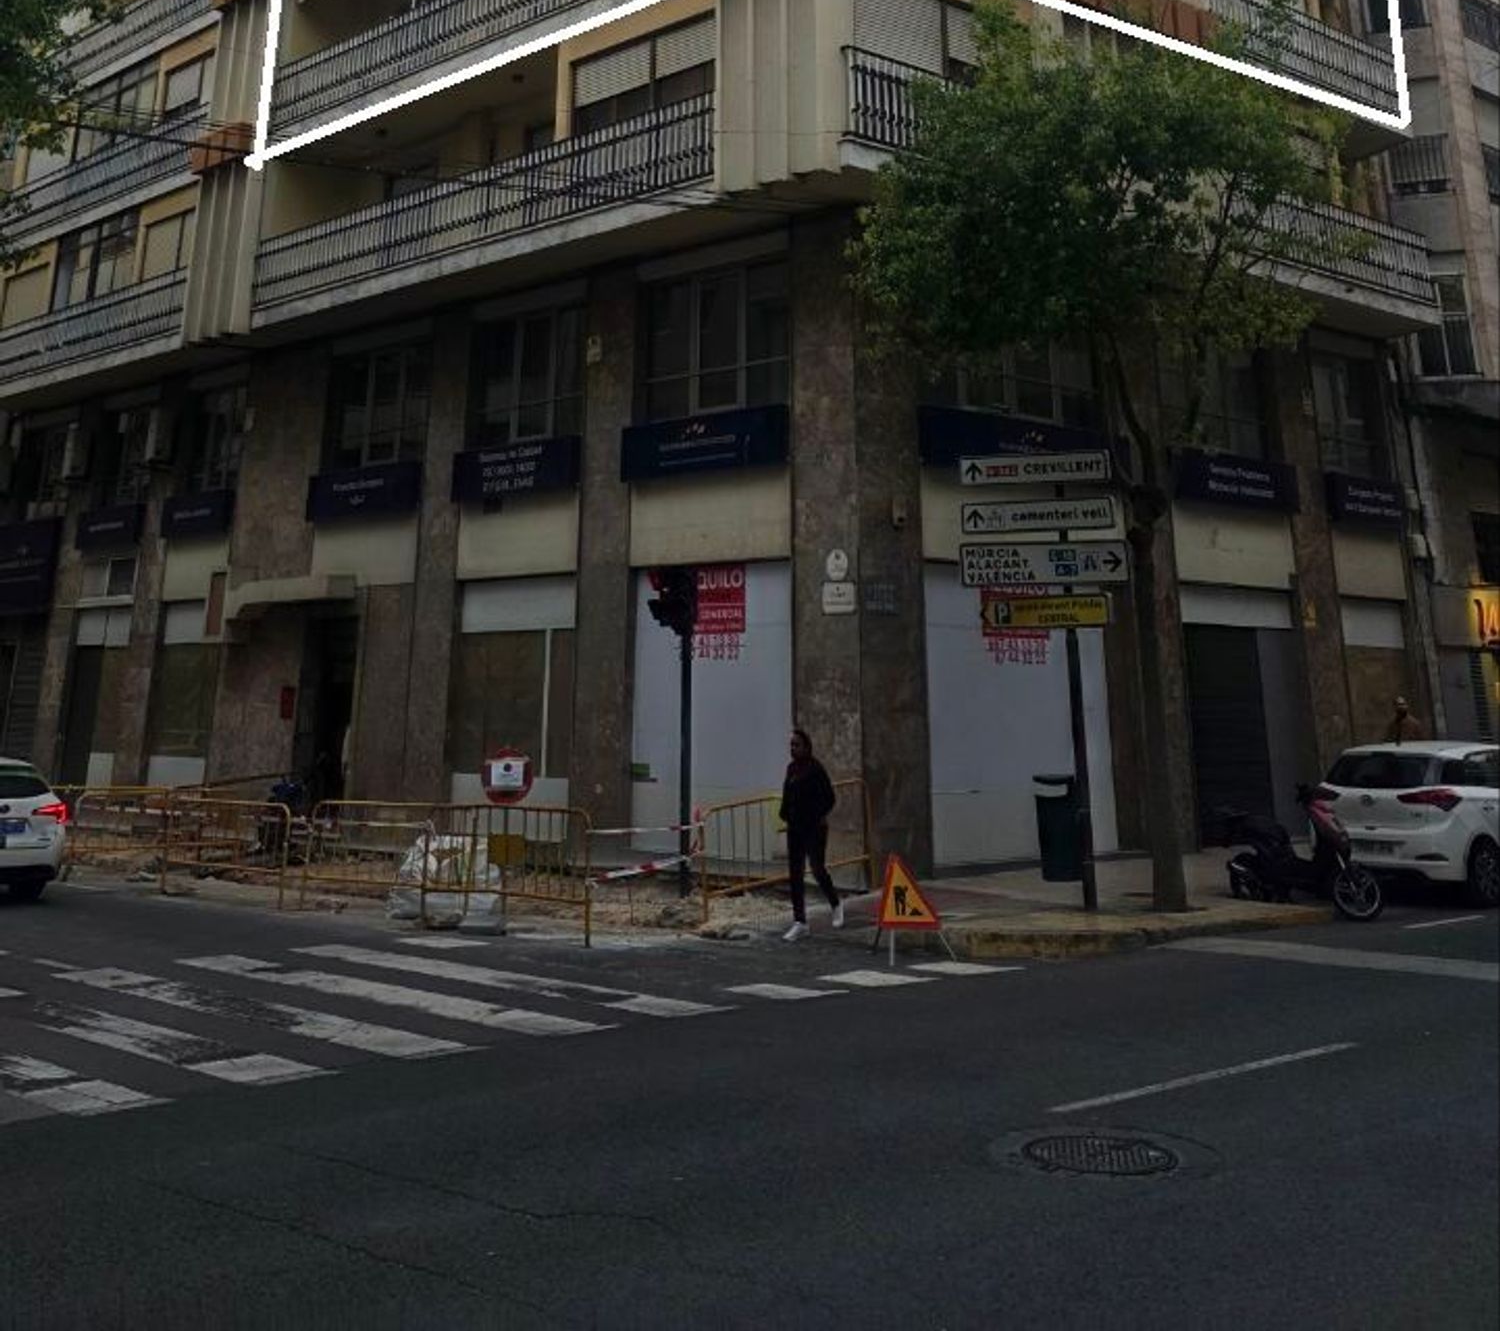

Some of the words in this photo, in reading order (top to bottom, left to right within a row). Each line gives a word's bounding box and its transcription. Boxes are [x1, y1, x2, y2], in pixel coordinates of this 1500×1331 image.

[1023, 459, 1102, 475] CREVILLENT
[1010, 508, 1079, 522] cementeri
[1081, 506, 1108, 518] vell
[967, 558, 1030, 569] ALACANT
